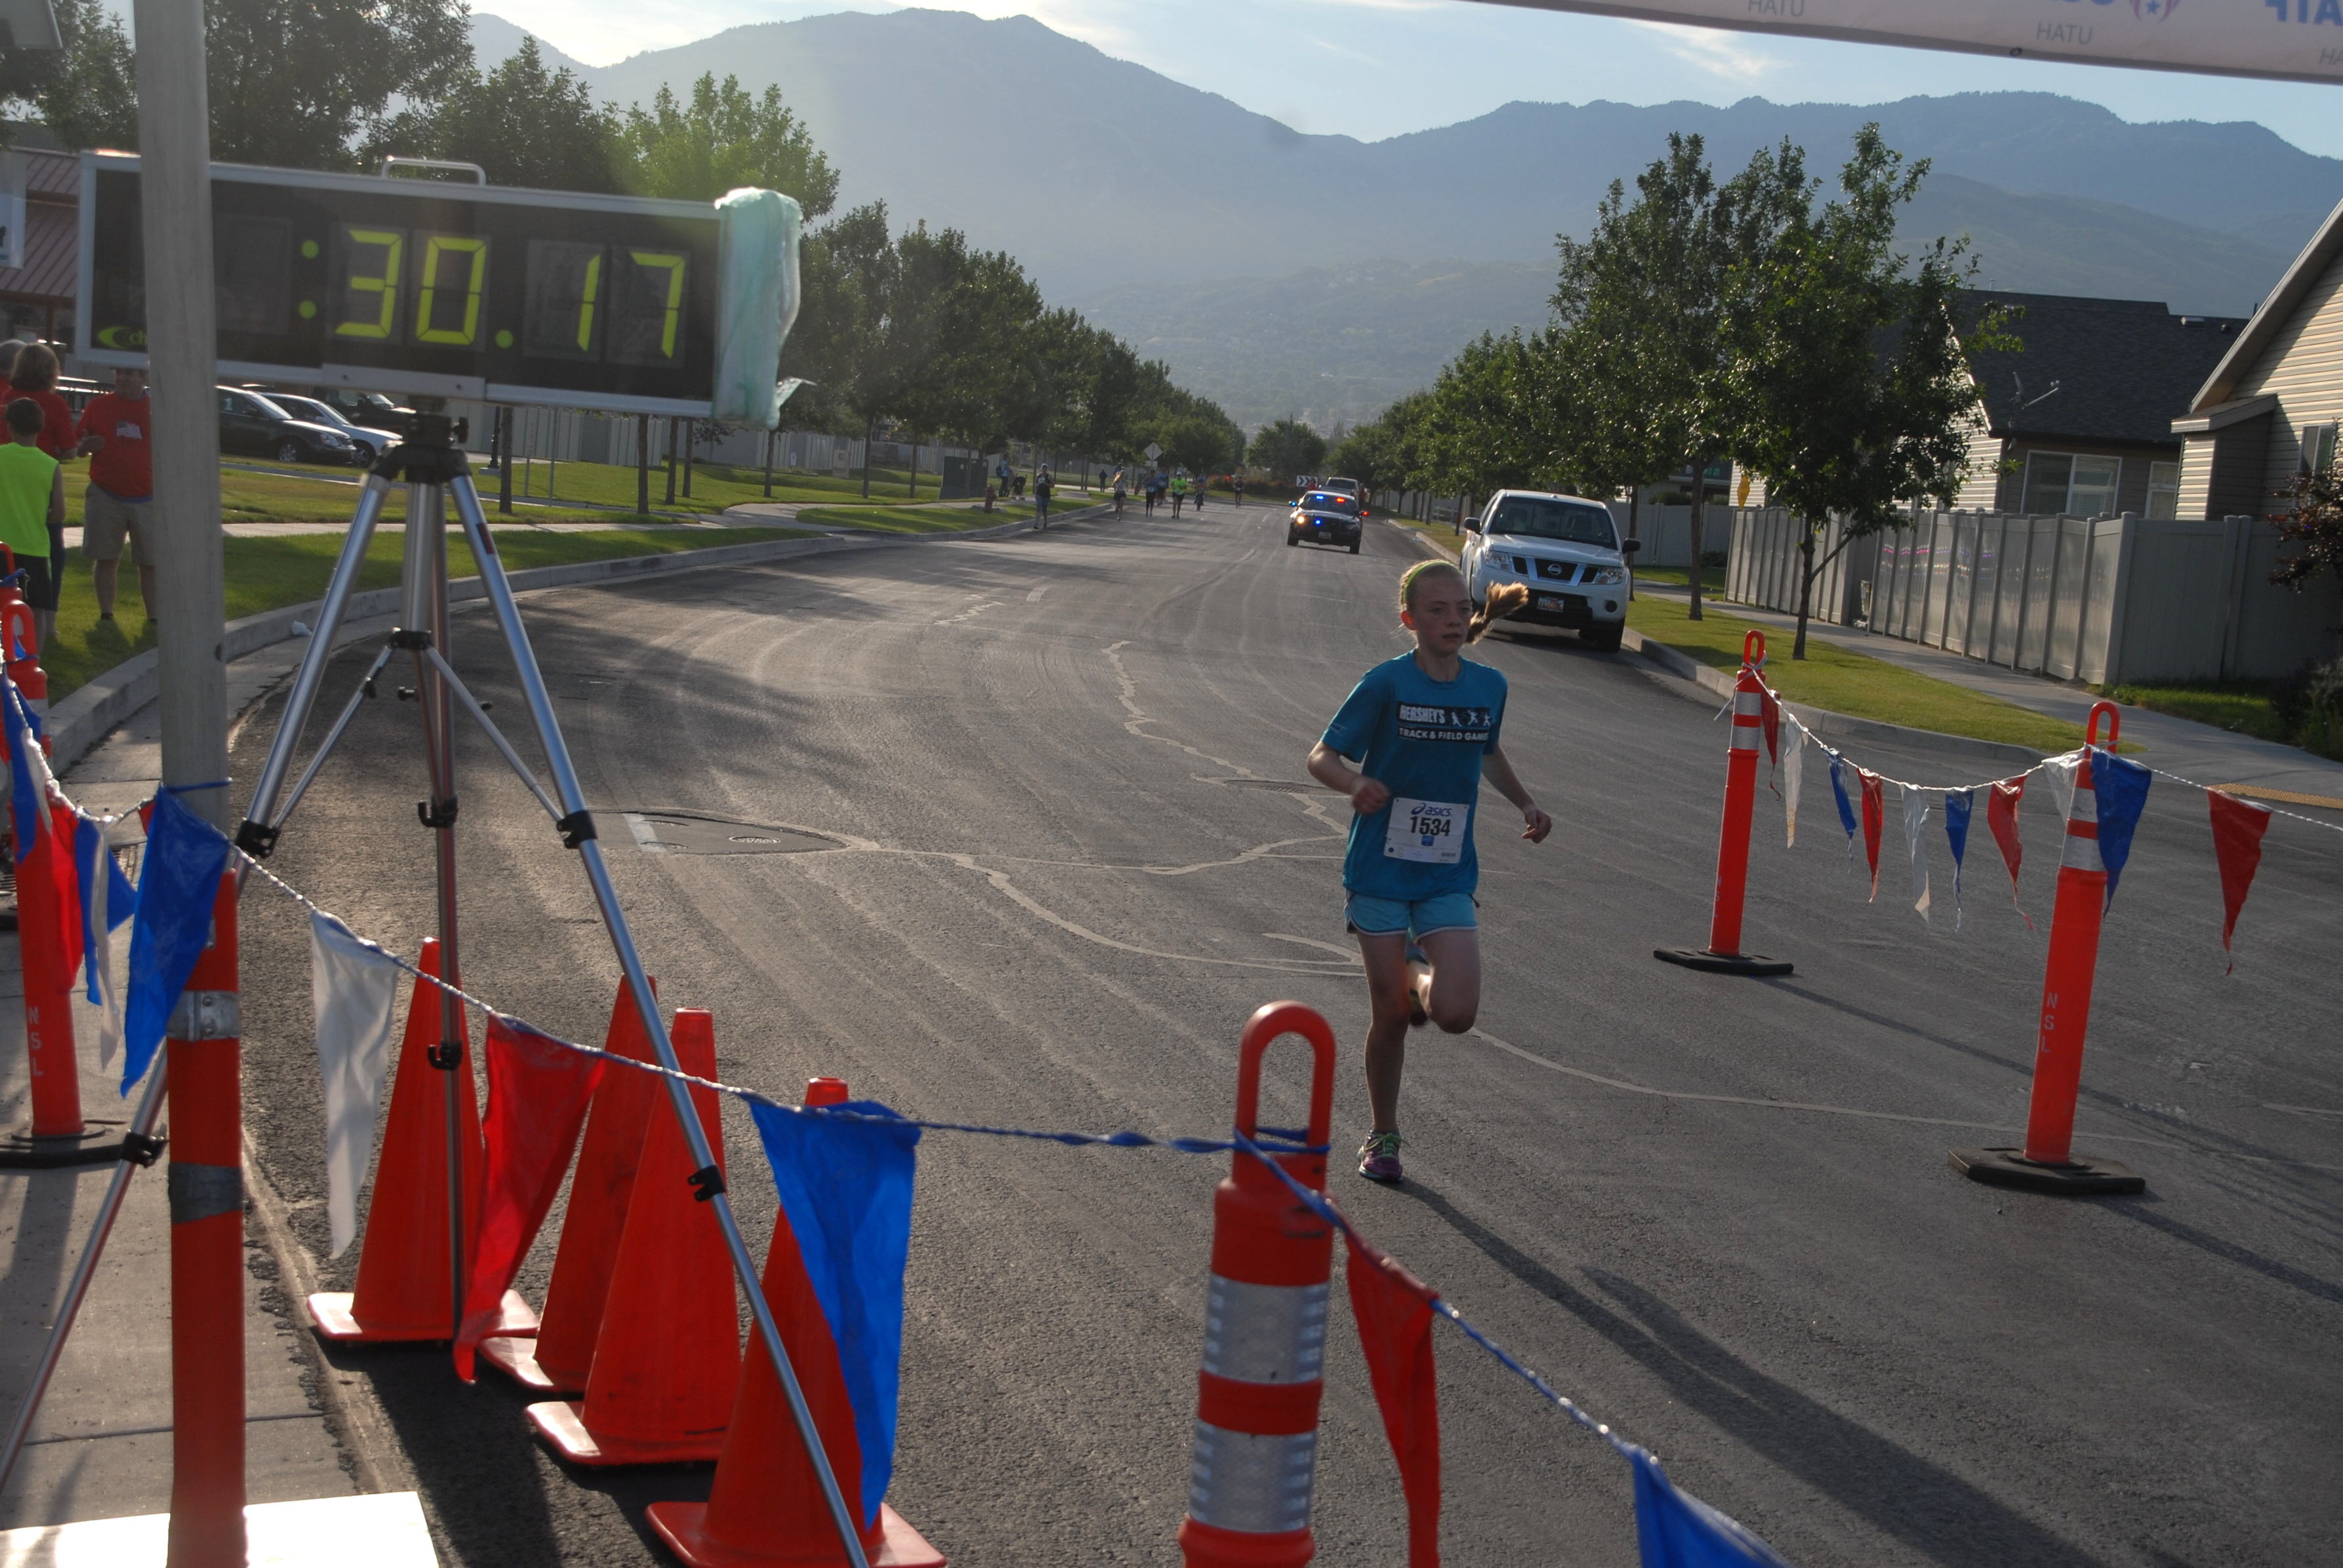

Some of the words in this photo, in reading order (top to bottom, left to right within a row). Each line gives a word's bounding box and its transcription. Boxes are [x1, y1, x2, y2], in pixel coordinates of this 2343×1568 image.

[1398, 728, 1428, 738] TRACK
[1429, 731, 1436, 739] &
[1410, 816, 1451, 836] 1534
